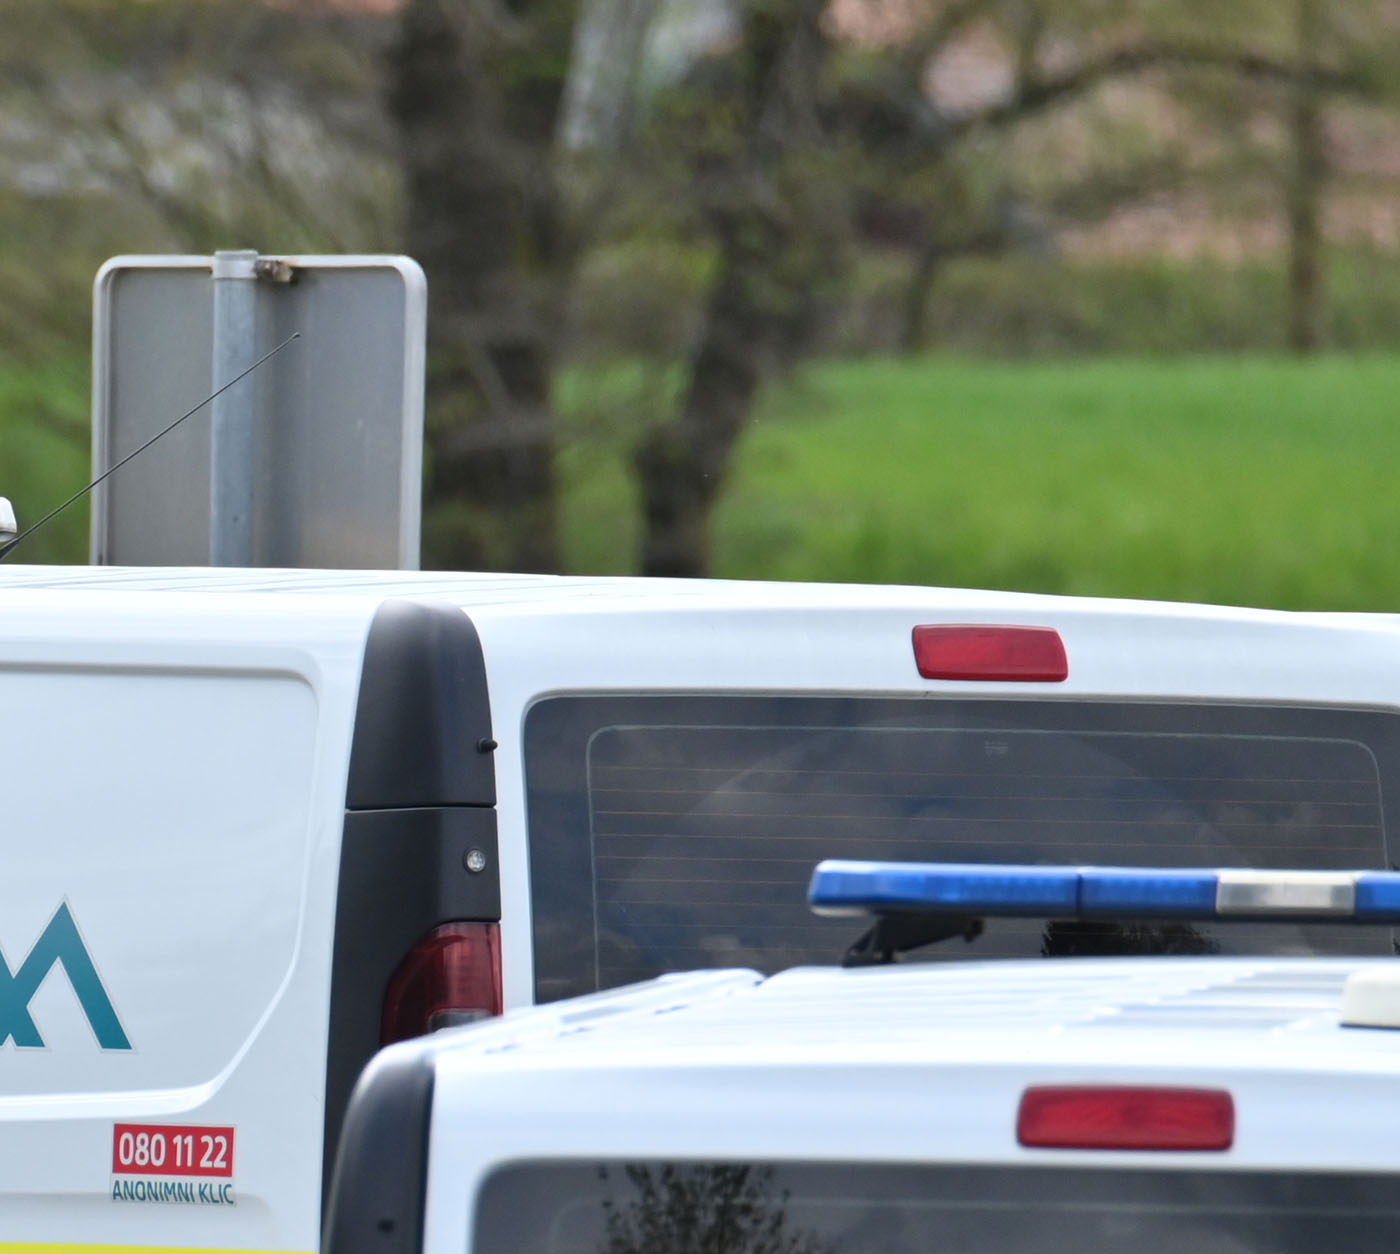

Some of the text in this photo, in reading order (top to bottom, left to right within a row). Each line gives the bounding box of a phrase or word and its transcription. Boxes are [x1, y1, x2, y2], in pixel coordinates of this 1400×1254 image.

[118, 1132, 228, 1169] 080 11 22
[112, 1180, 235, 1205] ANONIMNI KLIC
